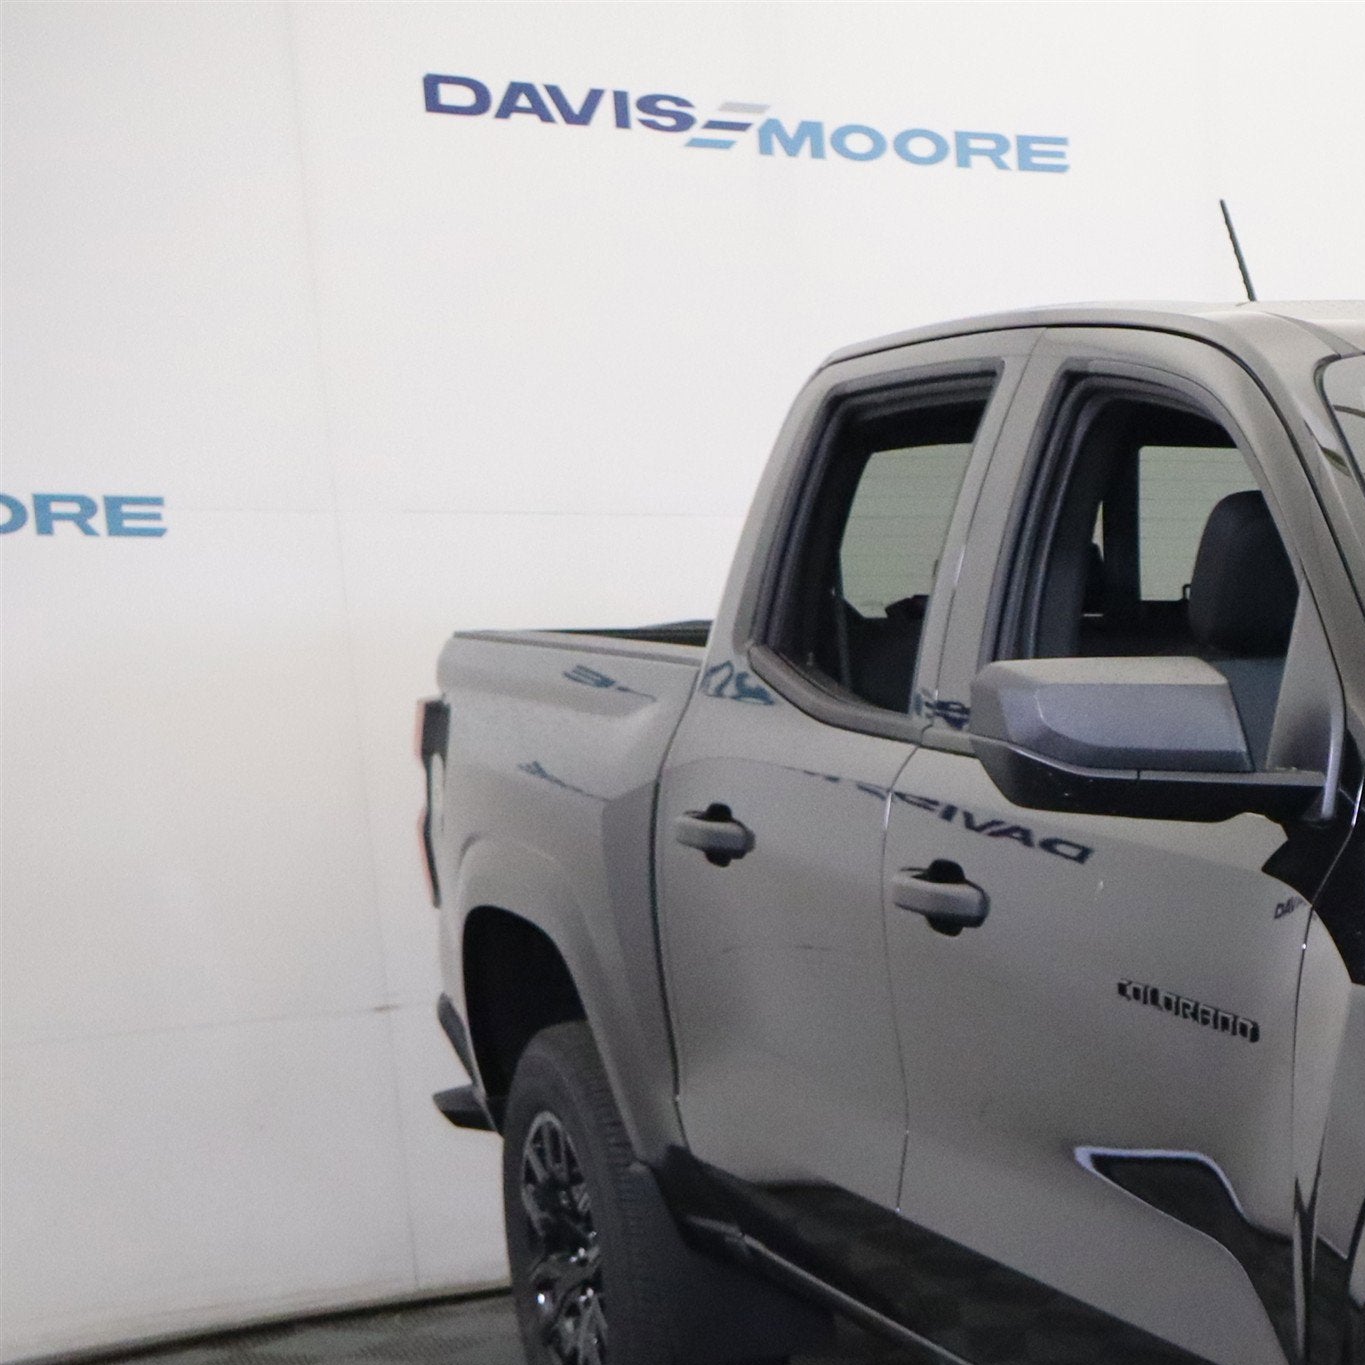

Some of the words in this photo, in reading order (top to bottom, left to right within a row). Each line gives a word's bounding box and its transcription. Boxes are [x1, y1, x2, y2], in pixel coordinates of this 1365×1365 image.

[422, 72, 698, 134] DAVIS
[757, 117, 1070, 173] MOORE
[1117, 978, 1260, 1043] COLORADO
